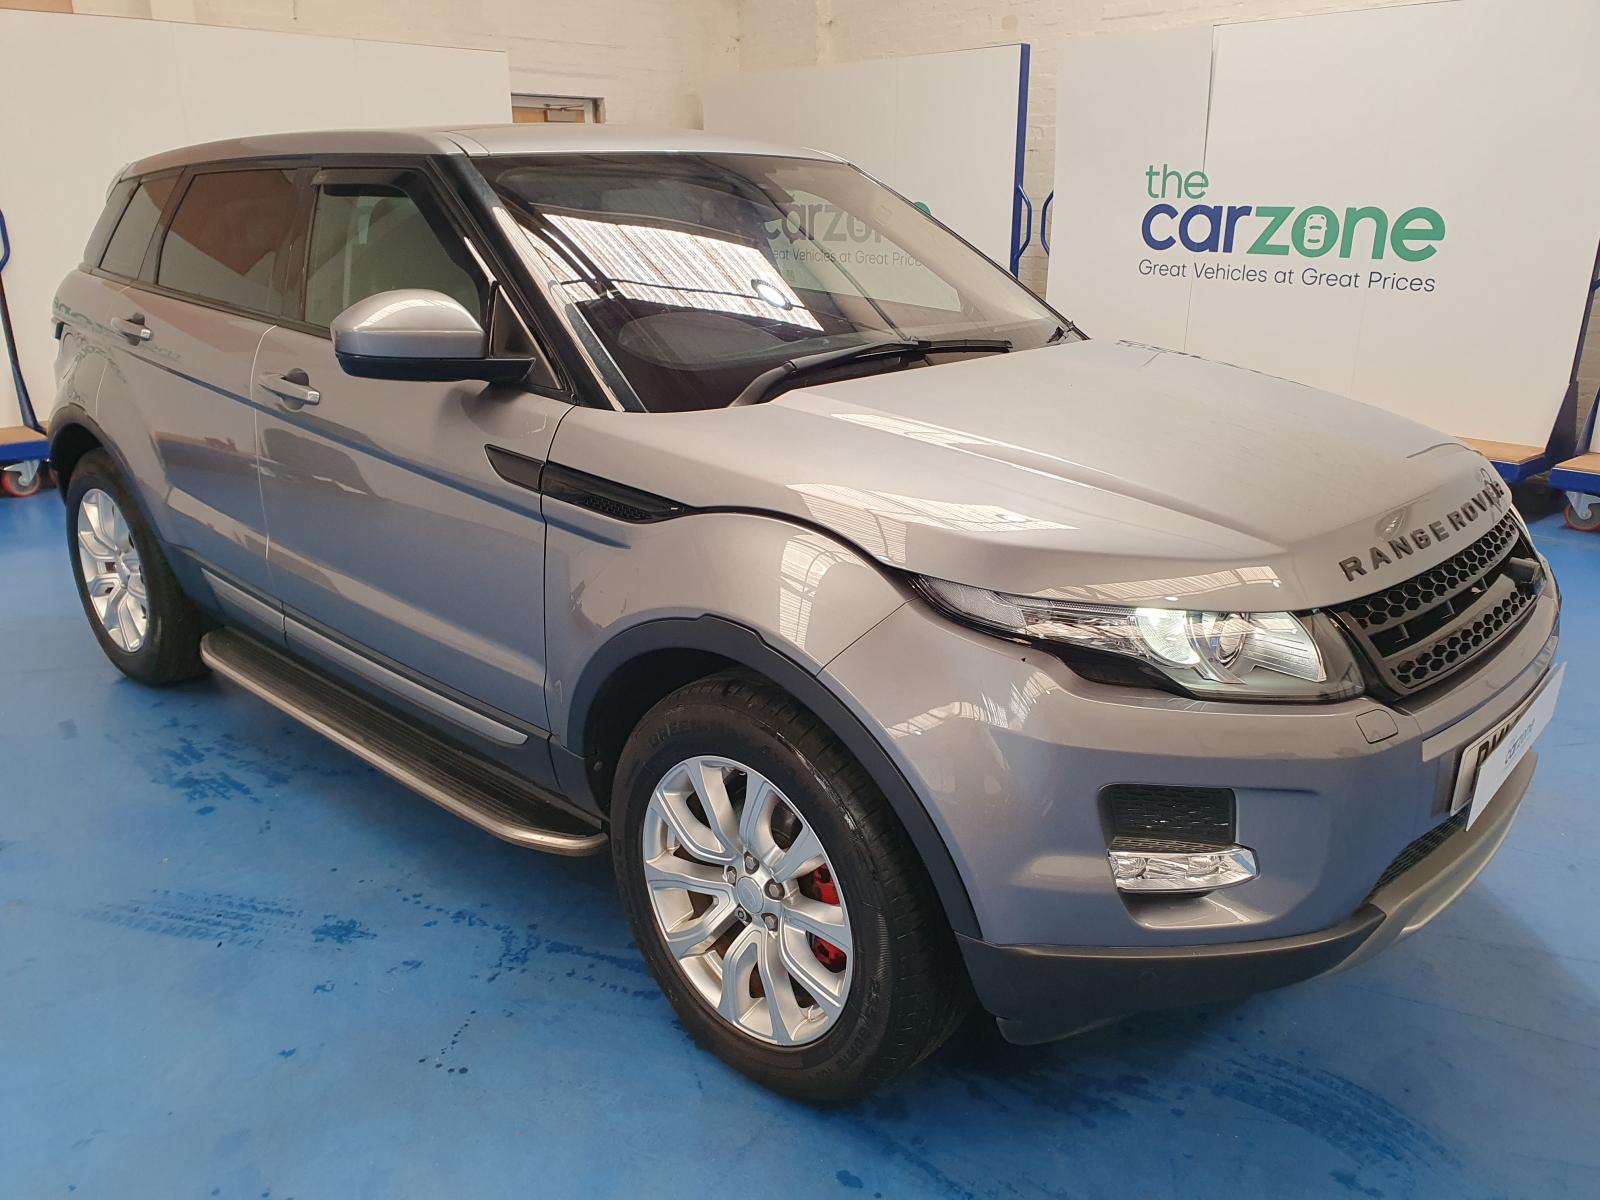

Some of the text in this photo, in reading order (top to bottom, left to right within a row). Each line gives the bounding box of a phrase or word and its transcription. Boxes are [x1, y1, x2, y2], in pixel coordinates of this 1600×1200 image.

[1145, 163, 1210, 200] the
[1141, 203, 1446, 263] carzone
[792, 247, 837, 264] Vehicles
[839, 250, 852, 264] at
[855, 249, 888, 265] Great
[1138, 259, 1436, 293] Great Vehicles at Great Prices
[1338, 480, 1505, 582] RANGE ROVER
